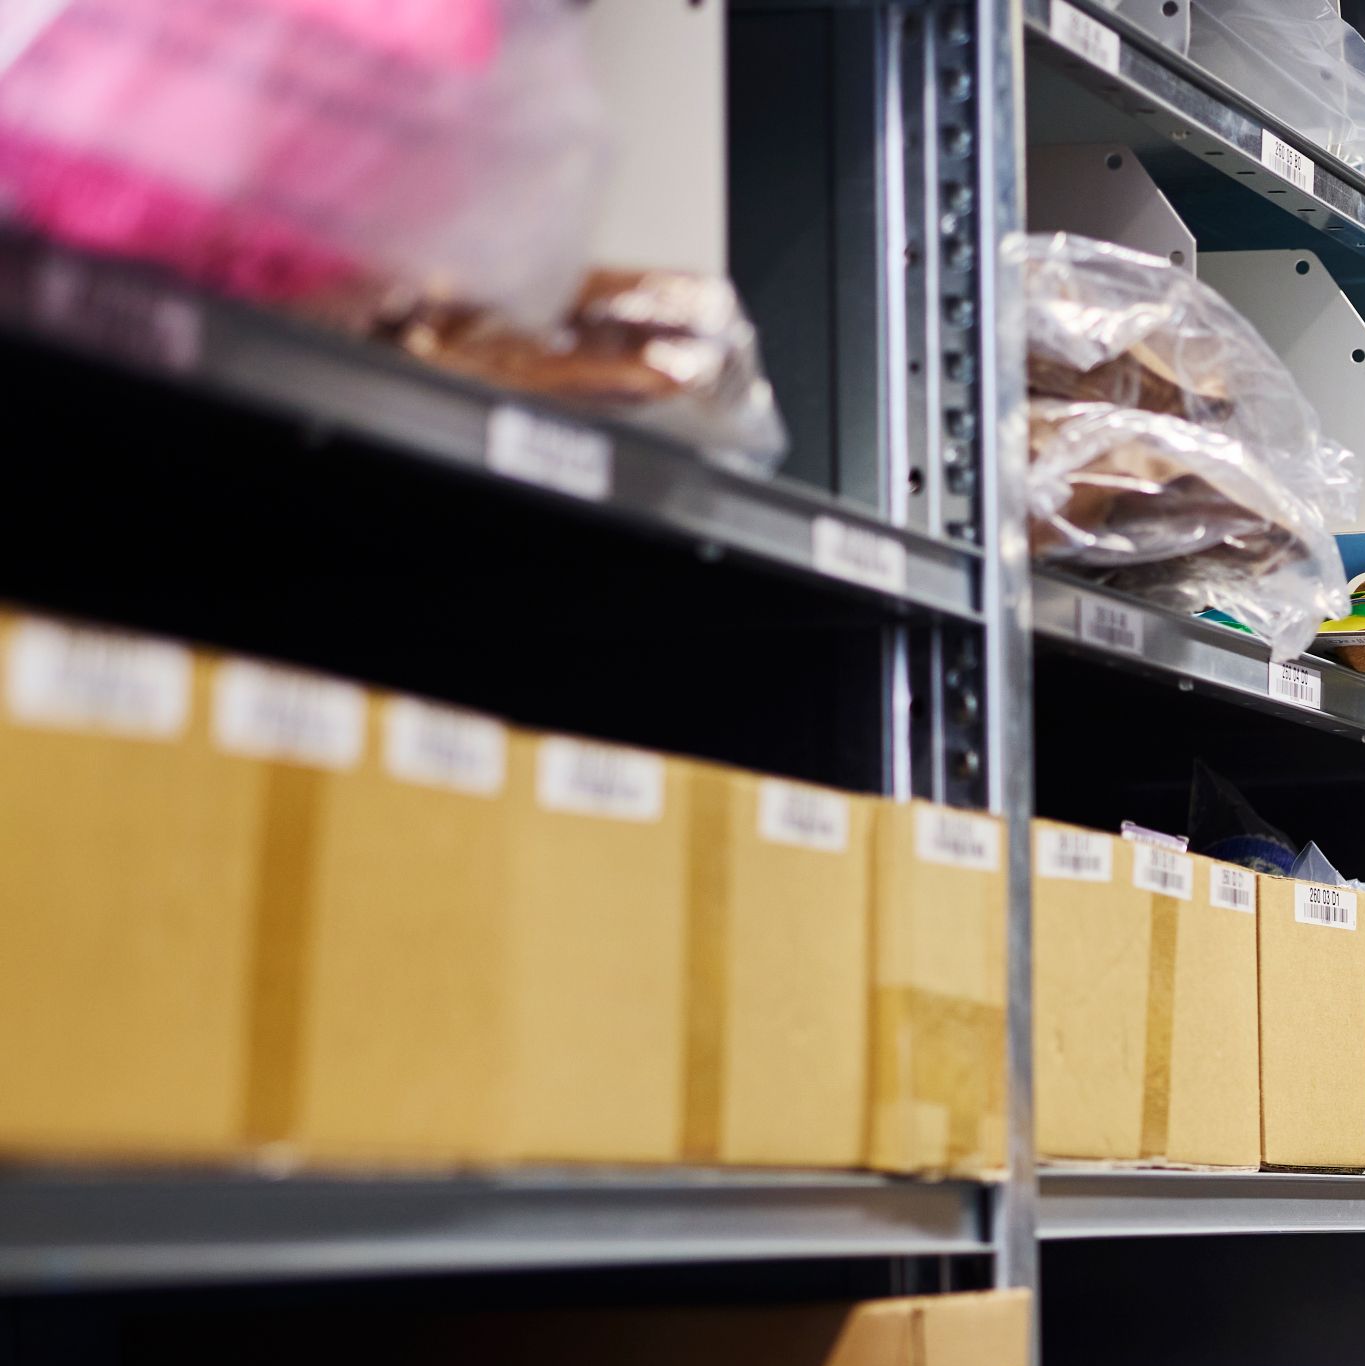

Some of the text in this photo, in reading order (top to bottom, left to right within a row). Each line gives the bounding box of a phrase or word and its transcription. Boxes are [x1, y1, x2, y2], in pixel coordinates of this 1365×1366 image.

[1275, 141, 1285, 160] 260
[1282, 663, 1292, 680] 260
[1309, 887, 1340, 907] 260 03 D1
